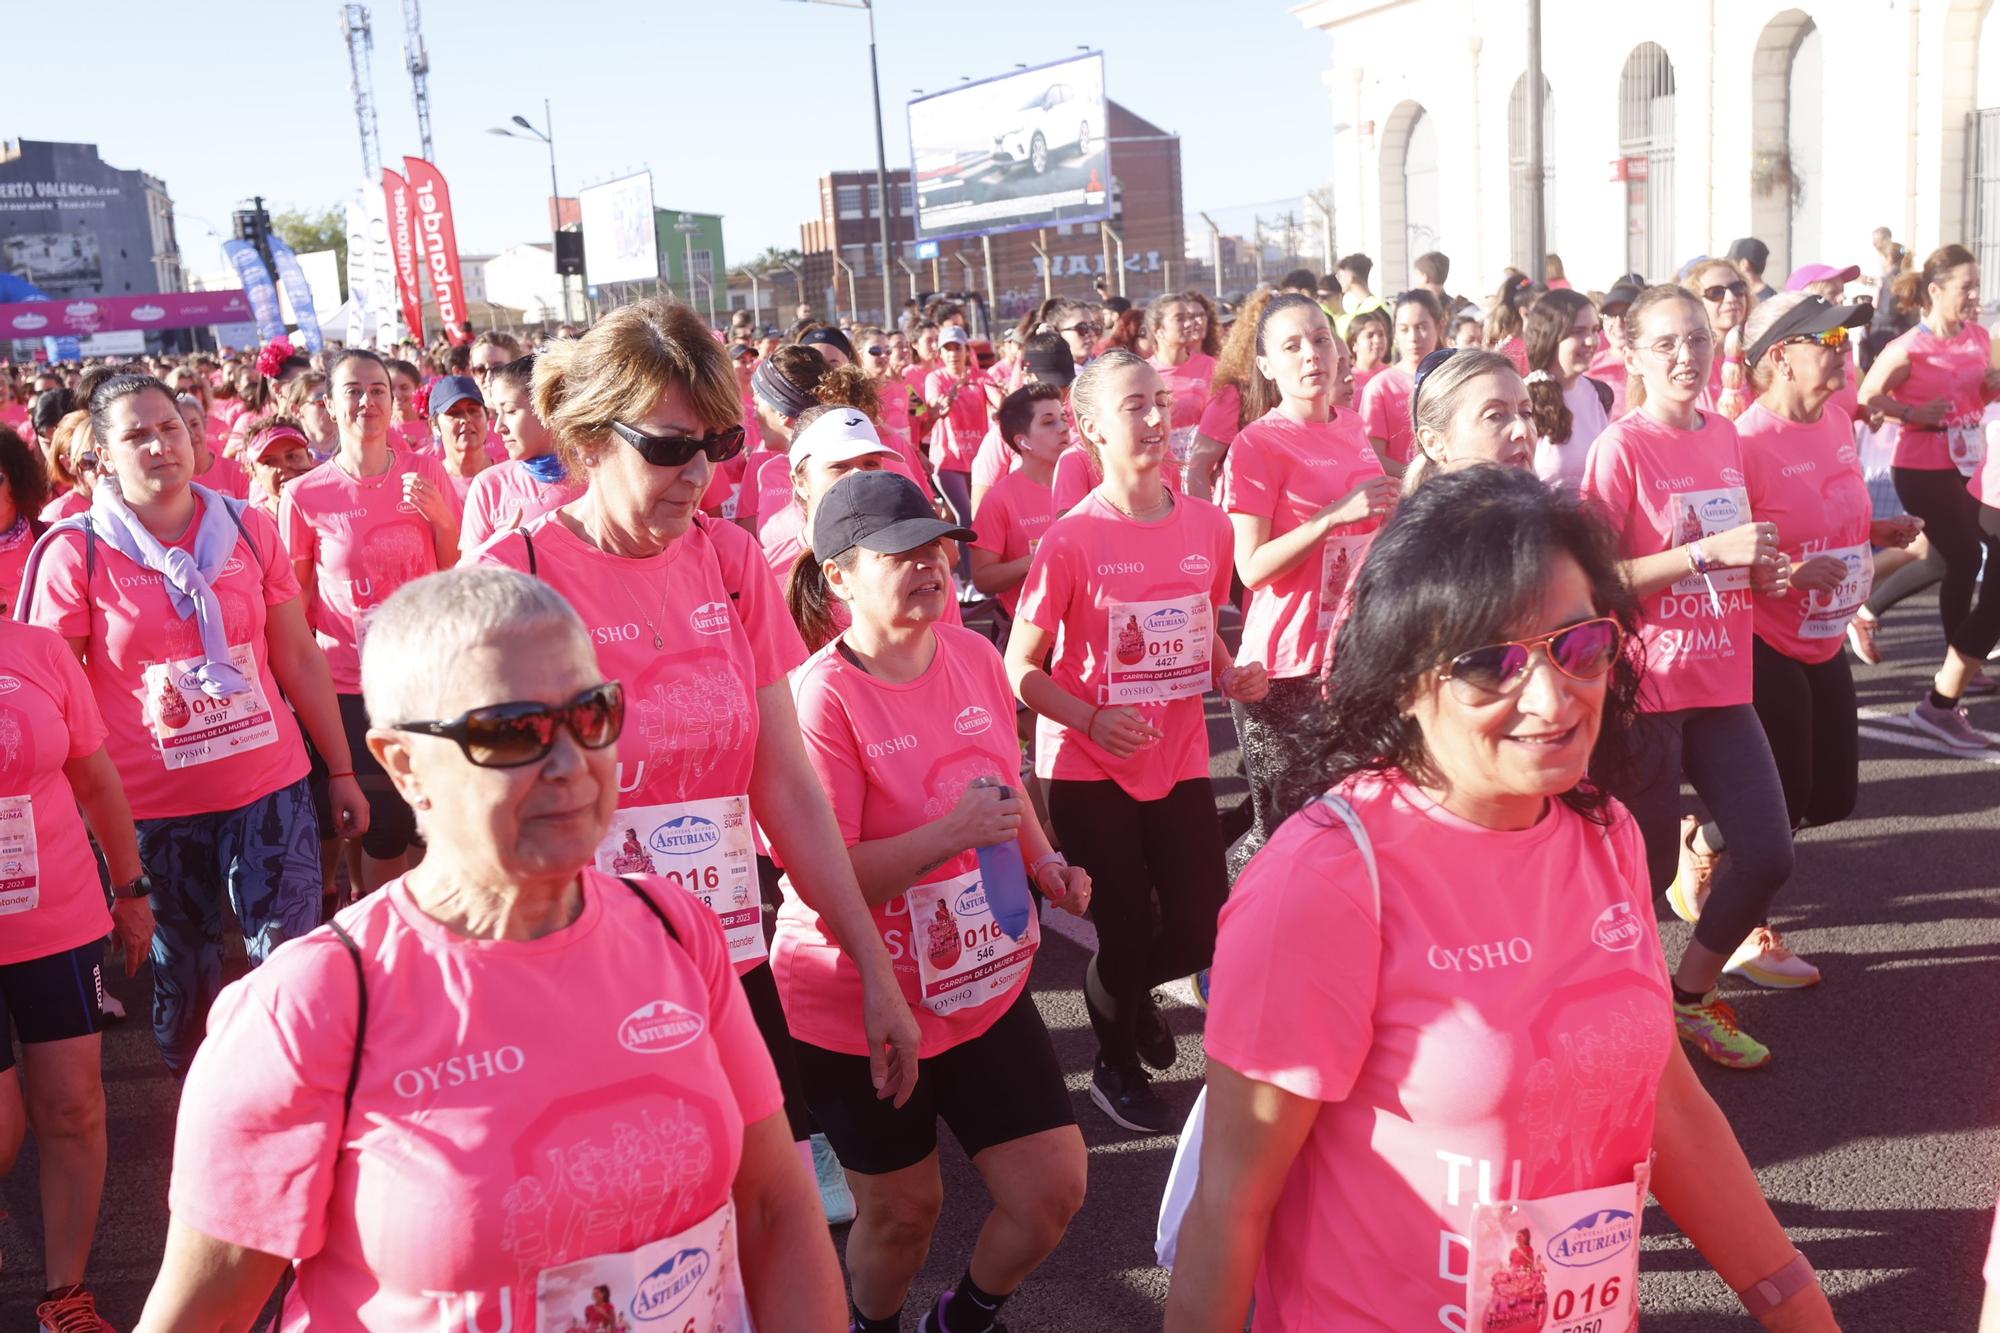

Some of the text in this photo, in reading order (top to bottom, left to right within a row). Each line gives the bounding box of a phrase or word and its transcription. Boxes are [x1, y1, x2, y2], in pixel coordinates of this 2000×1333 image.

[1097, 562, 1145, 575] OYSHO
[1836, 580, 1858, 596] 016
[1660, 588, 1752, 619] DORSAL
[1149, 638, 1184, 656] 016
[1660, 625, 1733, 652] SUMA
[1155, 656, 1177, 668] 4427
[1122, 671, 1153, 681] CARRERA
[1164, 670, 1172, 678] LA
[1120, 687, 1154, 697] OYSHO
[204, 711, 228, 725] 5997
[173, 733, 207, 745] CARRERA
[208, 730, 218, 738] DE
[218, 727, 228, 735] LA
[229, 721, 250, 732] MUJER
[175, 746, 212, 761] OYSHO
[866, 734, 918, 758] OYSHO
[616, 761, 645, 793] U
[724, 819, 743, 829] SUMA
[656, 830, 718, 849] ASTURIANA
[665, 866, 720, 891] 016
[735, 912, 751, 923] 2023
[727, 936, 755, 950] ntander
[964, 920, 1002, 948] 016
[977, 945, 994, 962] 546
[1427, 937, 1533, 971] OYSHO
[939, 974, 973, 991] CARRERA
[975, 970, 984, 979] DE
[984, 966, 993, 975] LA
[994, 955, 1015, 970] MUJER
[934, 989, 972, 1010] OYSHO
[627, 1020, 699, 1046] ASTURIANA
[393, 1046, 526, 1098] OYSHO
[1436, 1150, 1521, 1208] TU
[1555, 1227, 1632, 1258] ASTURIANA
[637, 1263, 702, 1314] ASTURIANA
[1552, 1276, 1621, 1321] 016
